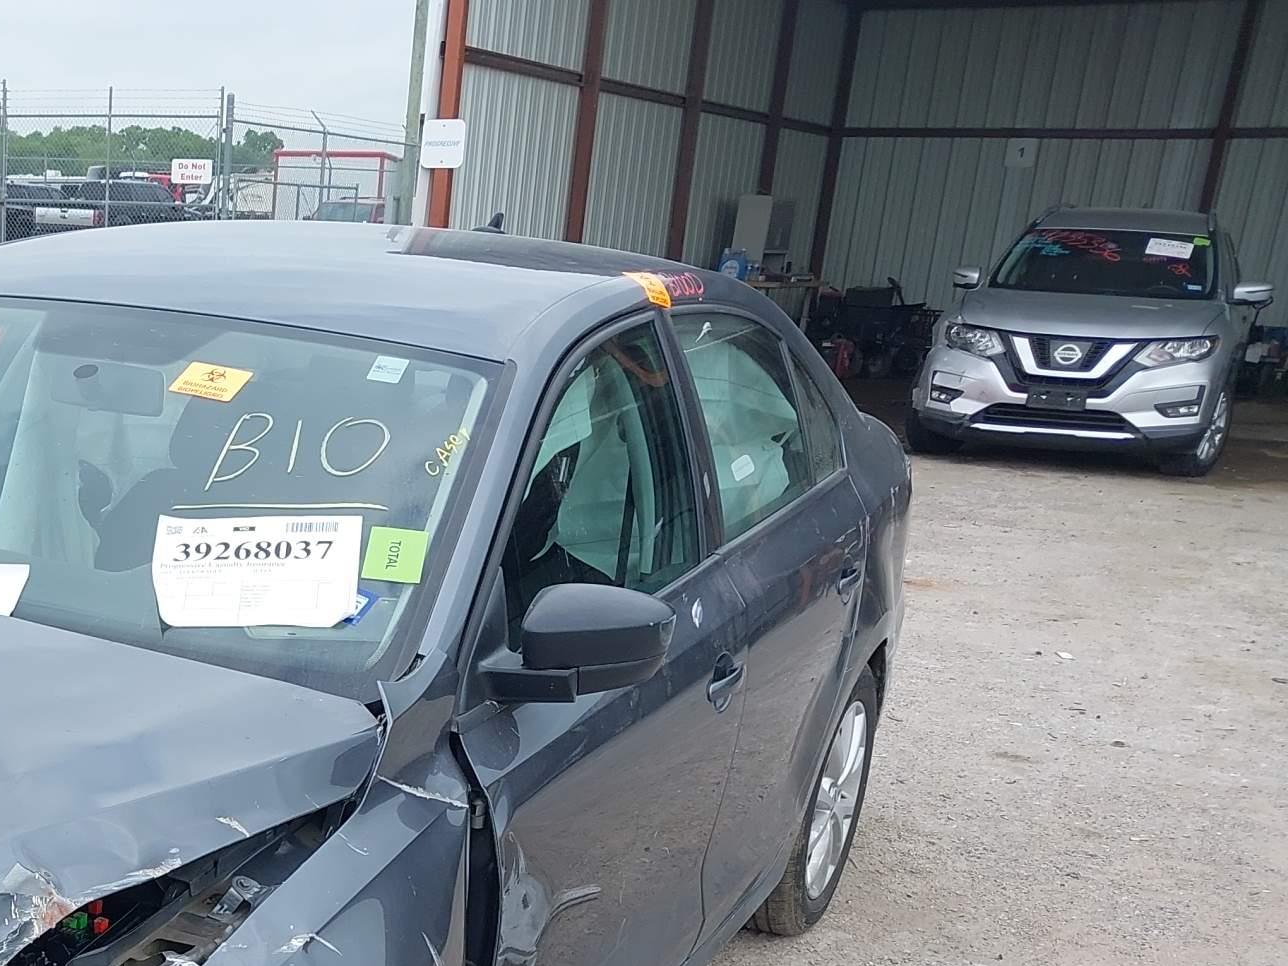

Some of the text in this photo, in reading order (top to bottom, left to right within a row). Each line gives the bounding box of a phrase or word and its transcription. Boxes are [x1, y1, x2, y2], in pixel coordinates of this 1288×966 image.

[178, 162, 206, 170] Do Not
[180, 173, 202, 181] Enter
[182, 380, 228, 393] BIOHAZARD
[172, 540, 334, 562] 39268037
[385, 540, 402, 570] TOTAL
